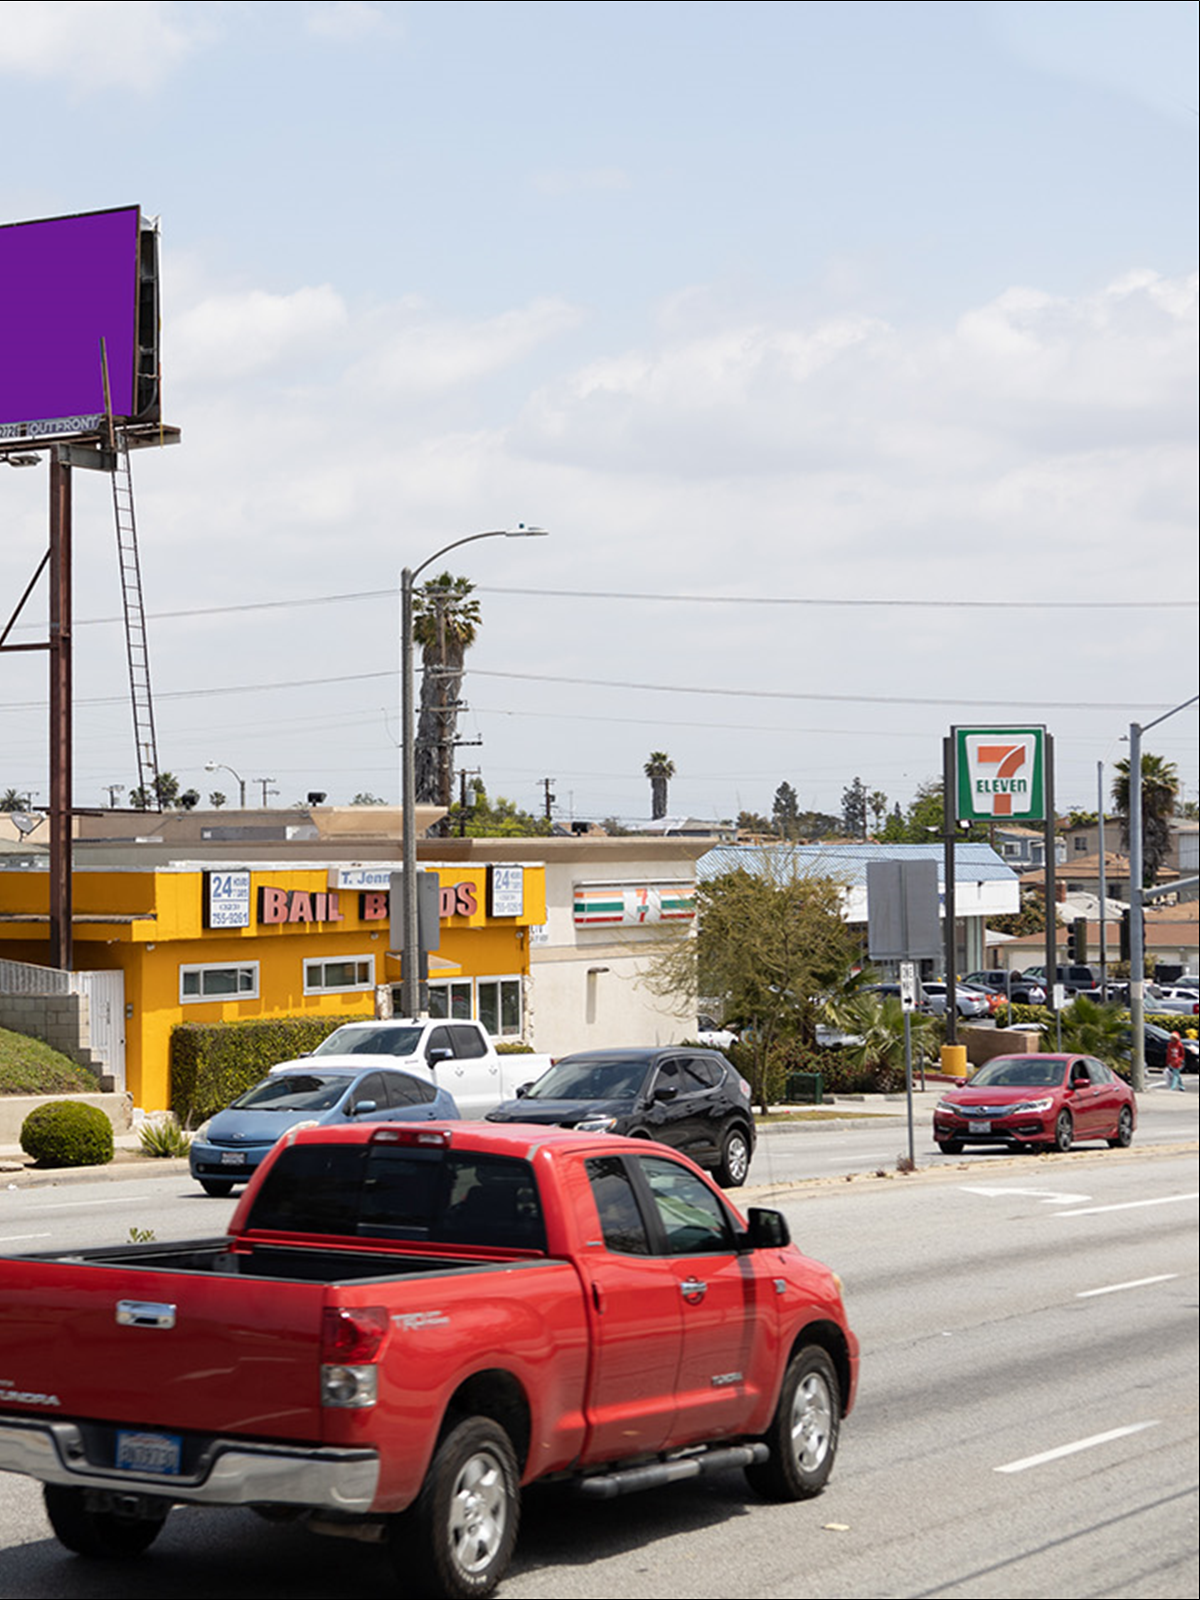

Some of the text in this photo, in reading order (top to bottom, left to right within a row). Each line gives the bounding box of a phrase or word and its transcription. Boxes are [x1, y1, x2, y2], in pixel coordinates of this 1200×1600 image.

[29, 416, 99, 435] OUTFRONT
[977, 744, 1025, 815] 7
[212, 875, 232, 898] 24
[341, 871, 353, 885] T.
[495, 870, 509, 889] 24
[263, 882, 478, 924] BAIL BDS
